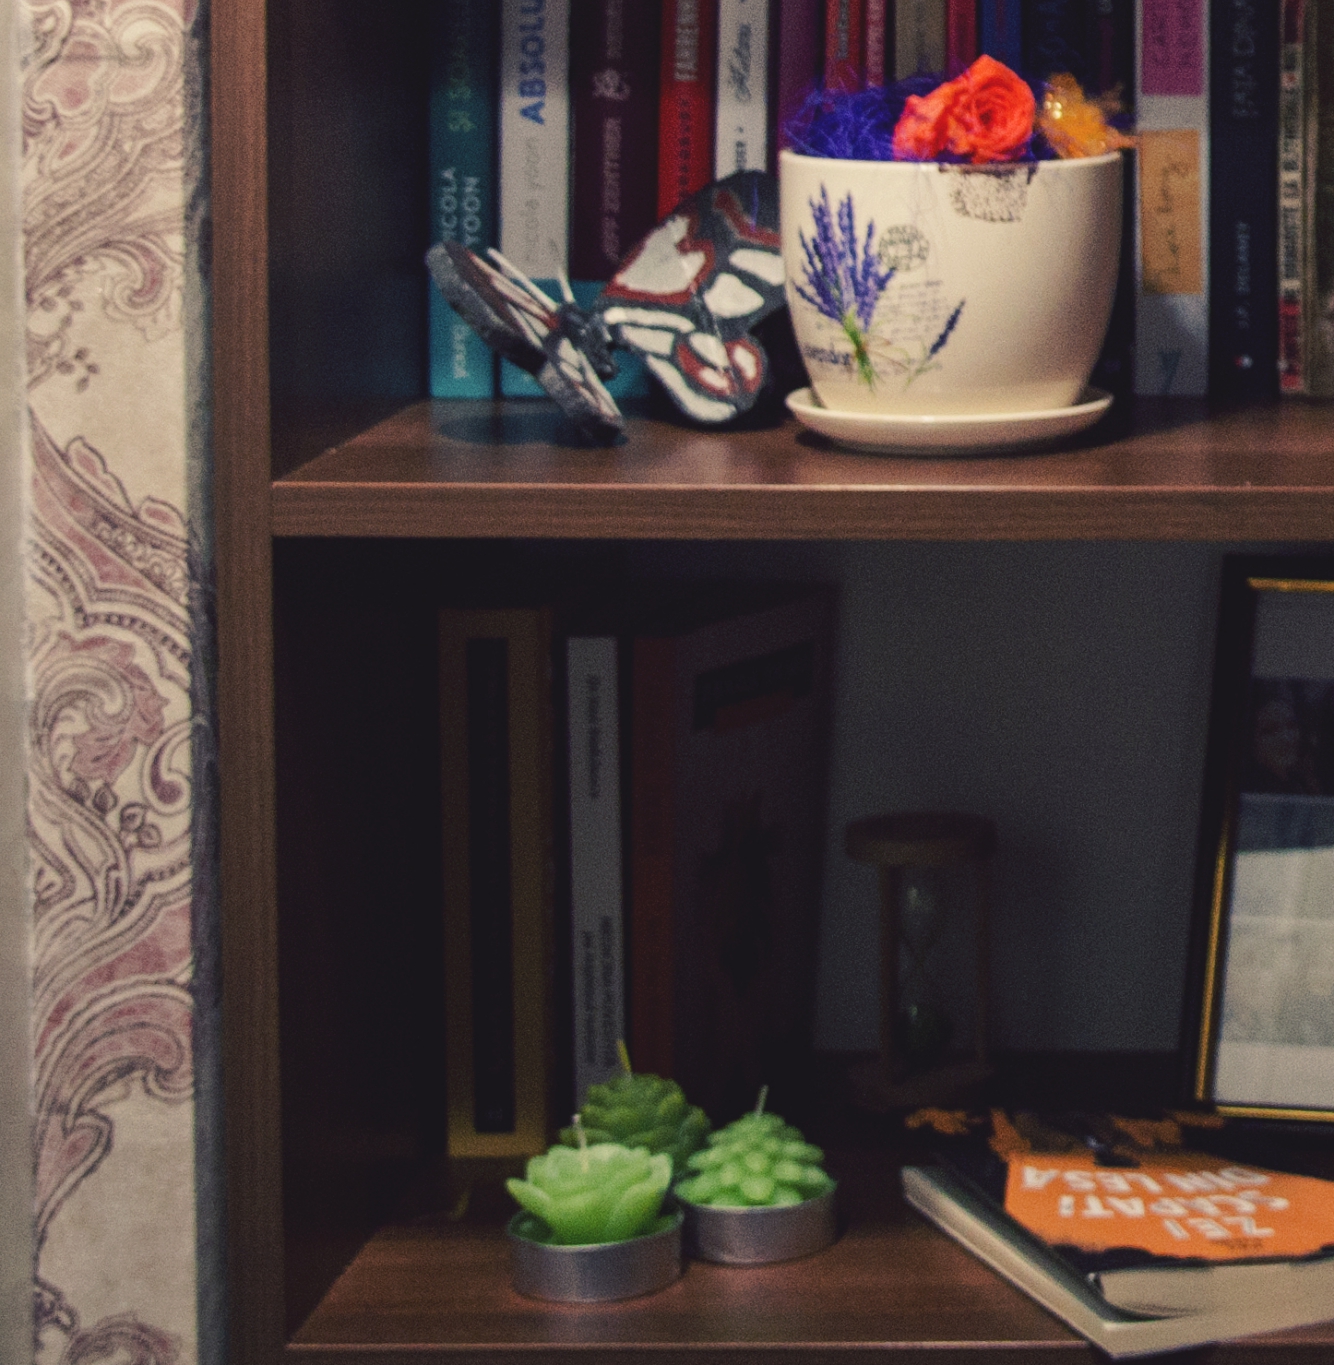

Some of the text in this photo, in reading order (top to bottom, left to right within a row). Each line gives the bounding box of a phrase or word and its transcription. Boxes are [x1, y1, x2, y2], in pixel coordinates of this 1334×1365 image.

[463, 176, 482, 247] YOON
[1163, 1166, 1271, 1193] DIN
[1163, 1216, 1275, 1241] ZEI
